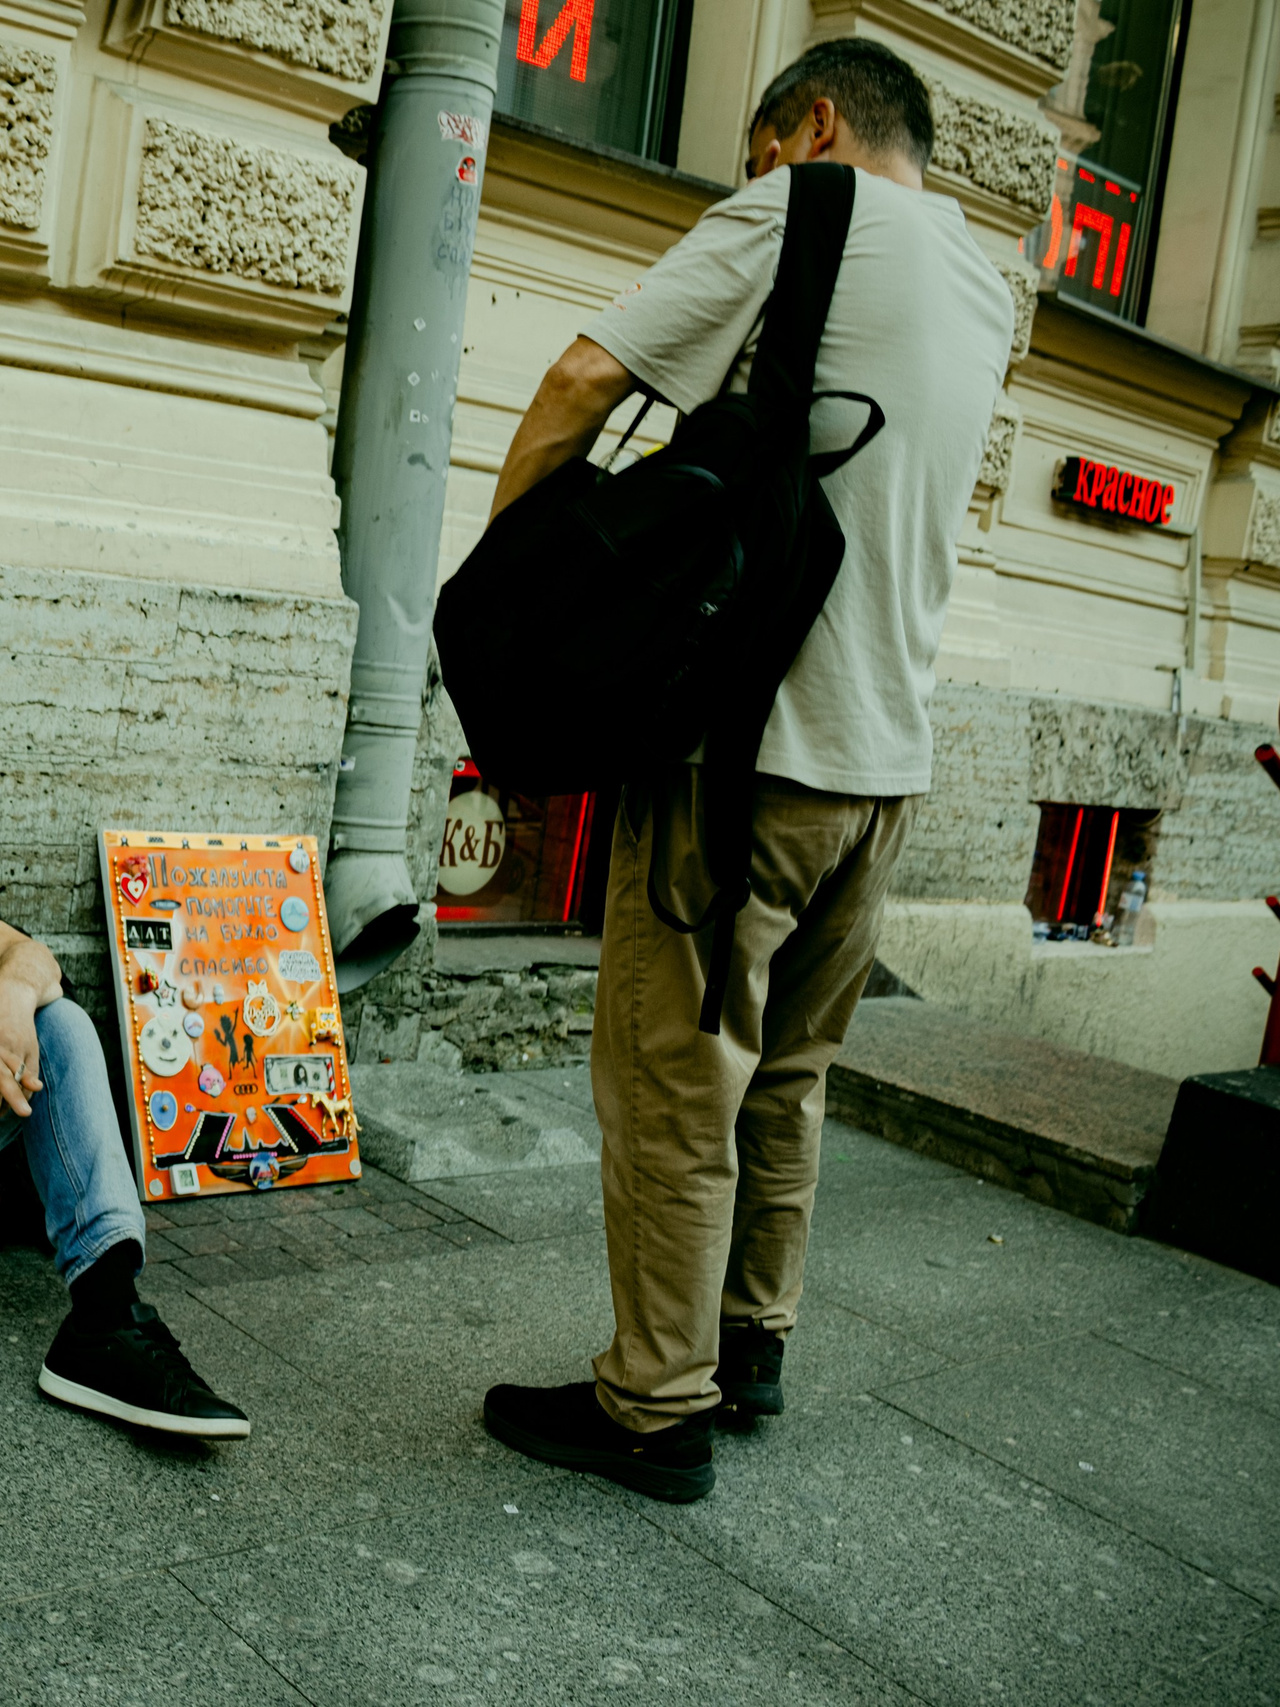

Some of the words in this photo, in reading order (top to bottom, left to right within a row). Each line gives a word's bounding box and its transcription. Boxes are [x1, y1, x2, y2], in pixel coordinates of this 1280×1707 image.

[186, 895, 278, 919] ПОМОГИТЕ
[185, 924, 209, 942] НА
[221, 923, 279, 943] БУХЛО
[179, 957, 269, 977] СПАСИБО
